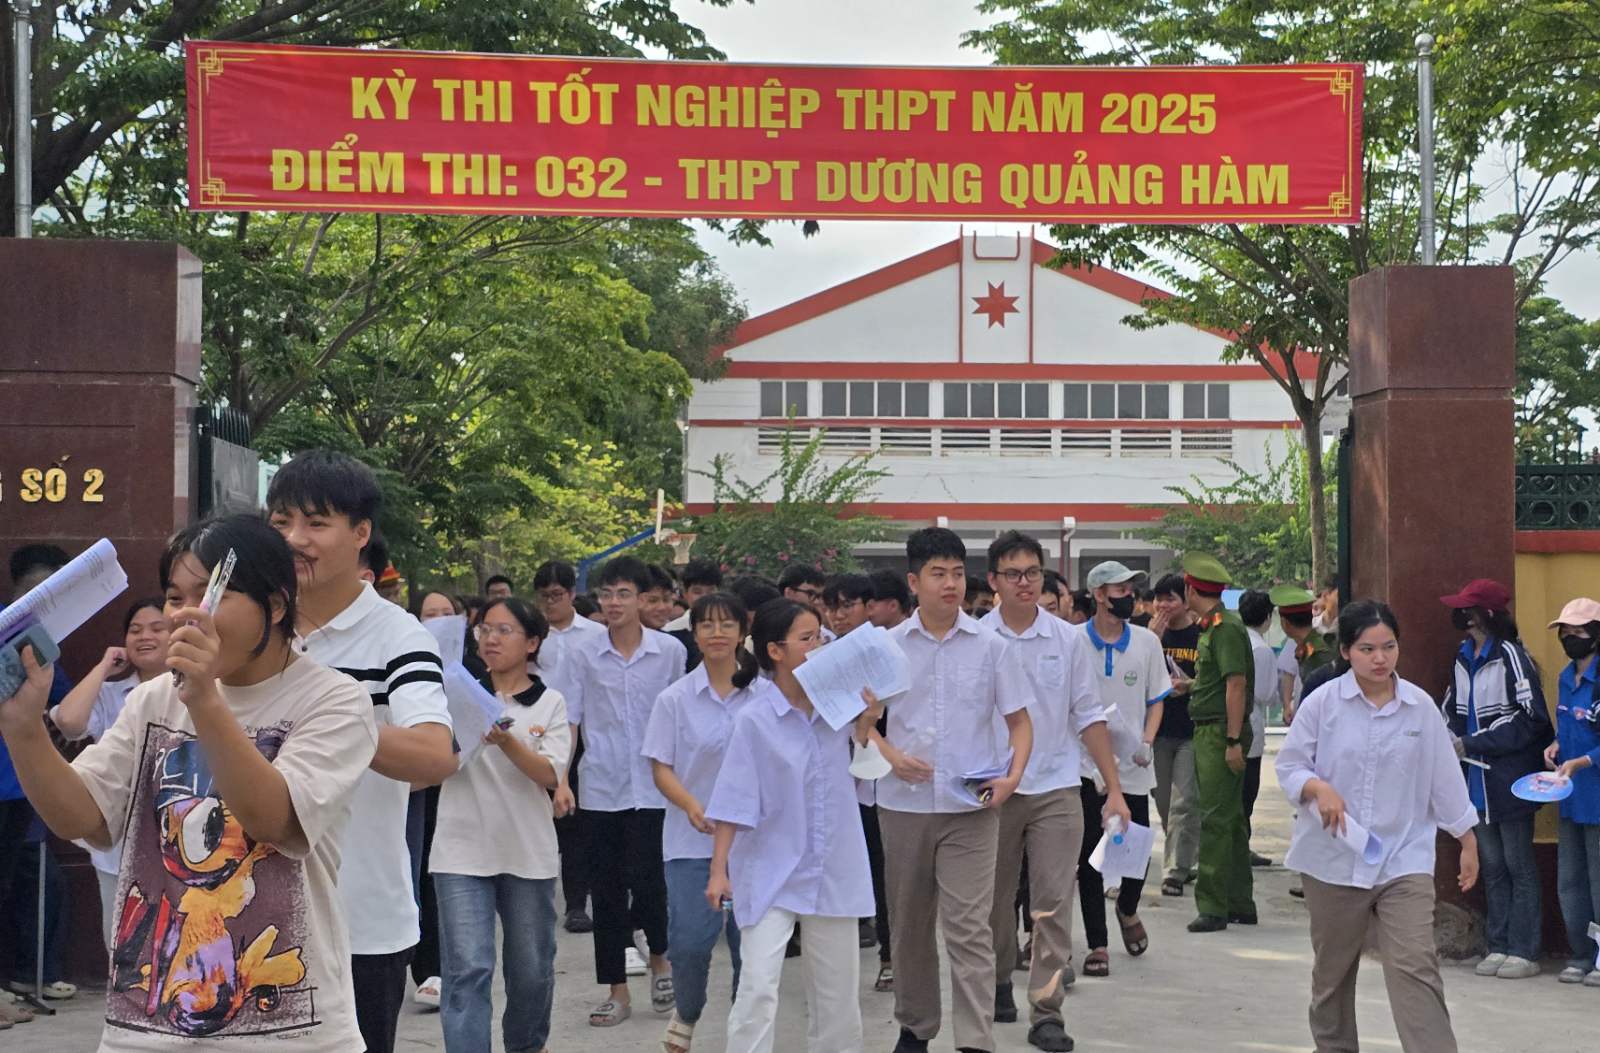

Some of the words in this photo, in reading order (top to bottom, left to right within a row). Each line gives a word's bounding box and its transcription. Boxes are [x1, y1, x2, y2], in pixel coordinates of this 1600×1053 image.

[351, 69, 416, 121] KỲ
[432, 79, 513, 123] THI
[529, 68, 620, 125] TỐT
[636, 78, 821, 139] NGHIỆP
[836, 88, 957, 132] THPT
[972, 82, 1084, 133] NĂM
[1100, 92, 1217, 135] 2025
[270, 133, 405, 194] ĐIỂM
[421, 152, 518, 196] THI:
[535, 155, 628, 199] 032
[644, 176, 661, 186] -
[678, 158, 801, 202] THPT
[816, 157, 982, 204] DƯƠNG
[1000, 150, 1164, 209] QUẢNG
[1180, 155, 1289, 206] HÀM
[83, 468, 104, 502] 2
